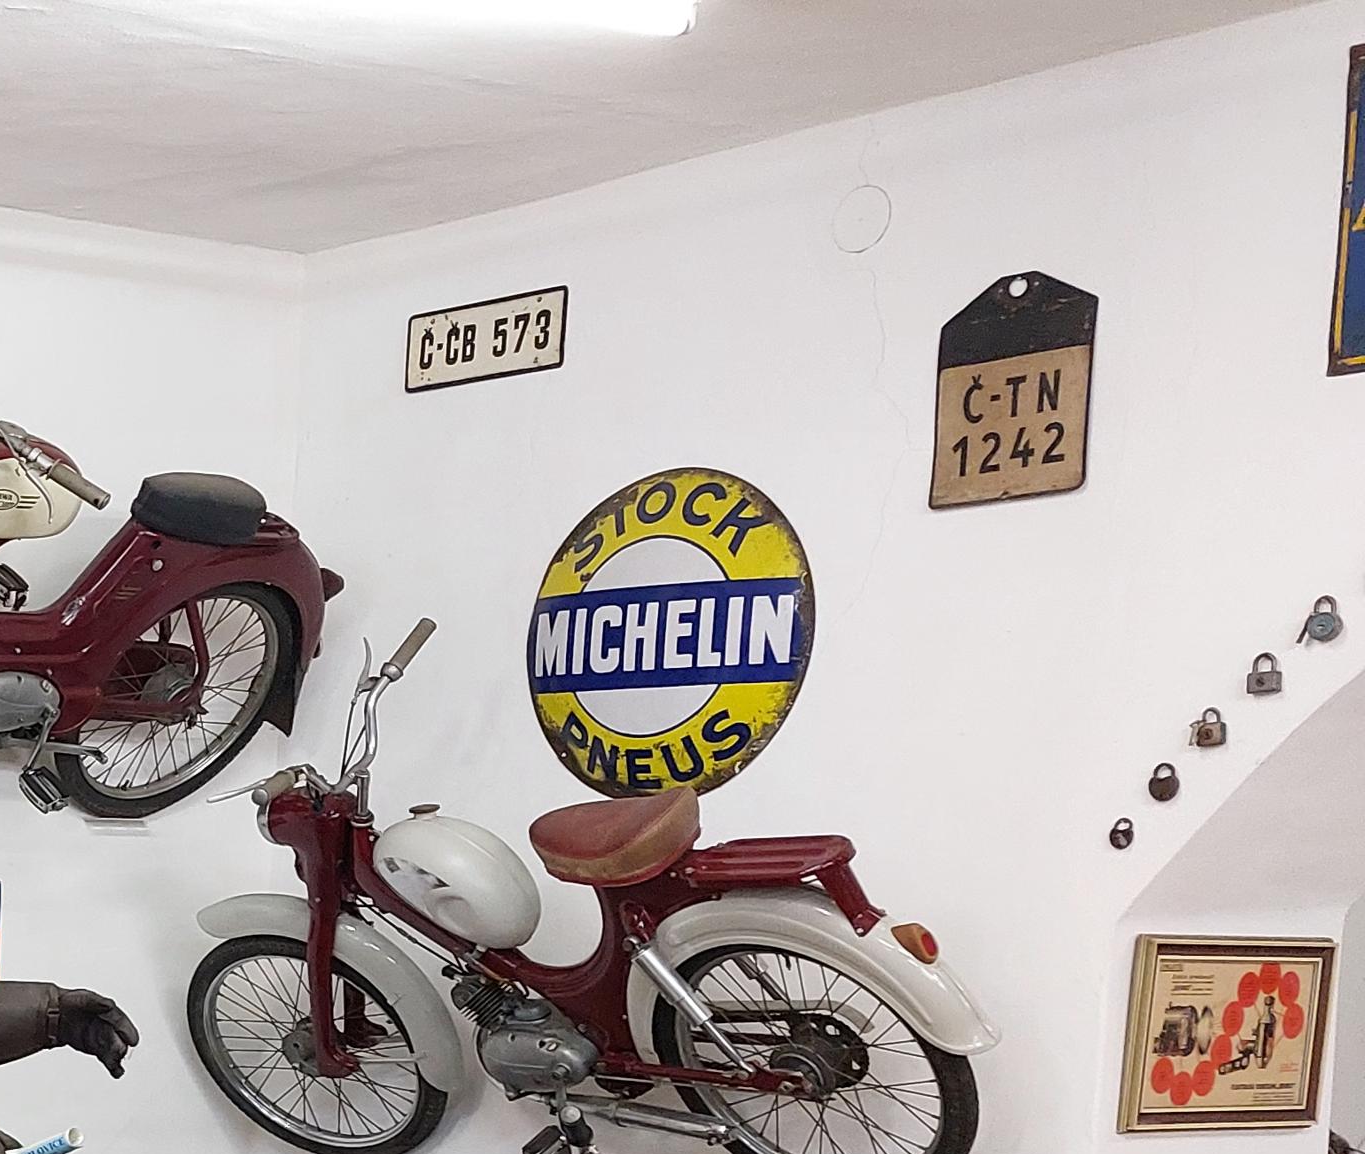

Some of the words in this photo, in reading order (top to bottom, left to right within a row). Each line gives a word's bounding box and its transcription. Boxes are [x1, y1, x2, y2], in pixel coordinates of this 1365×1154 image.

[419, 321, 476, 369] Č-ČB
[492, 310, 551, 357] 573
[952, 422, 1065, 477] 1242
[573, 481, 768, 572] STOCK
[535, 593, 797, 679] MICHELIN
[558, 708, 751, 791] PNEUS
